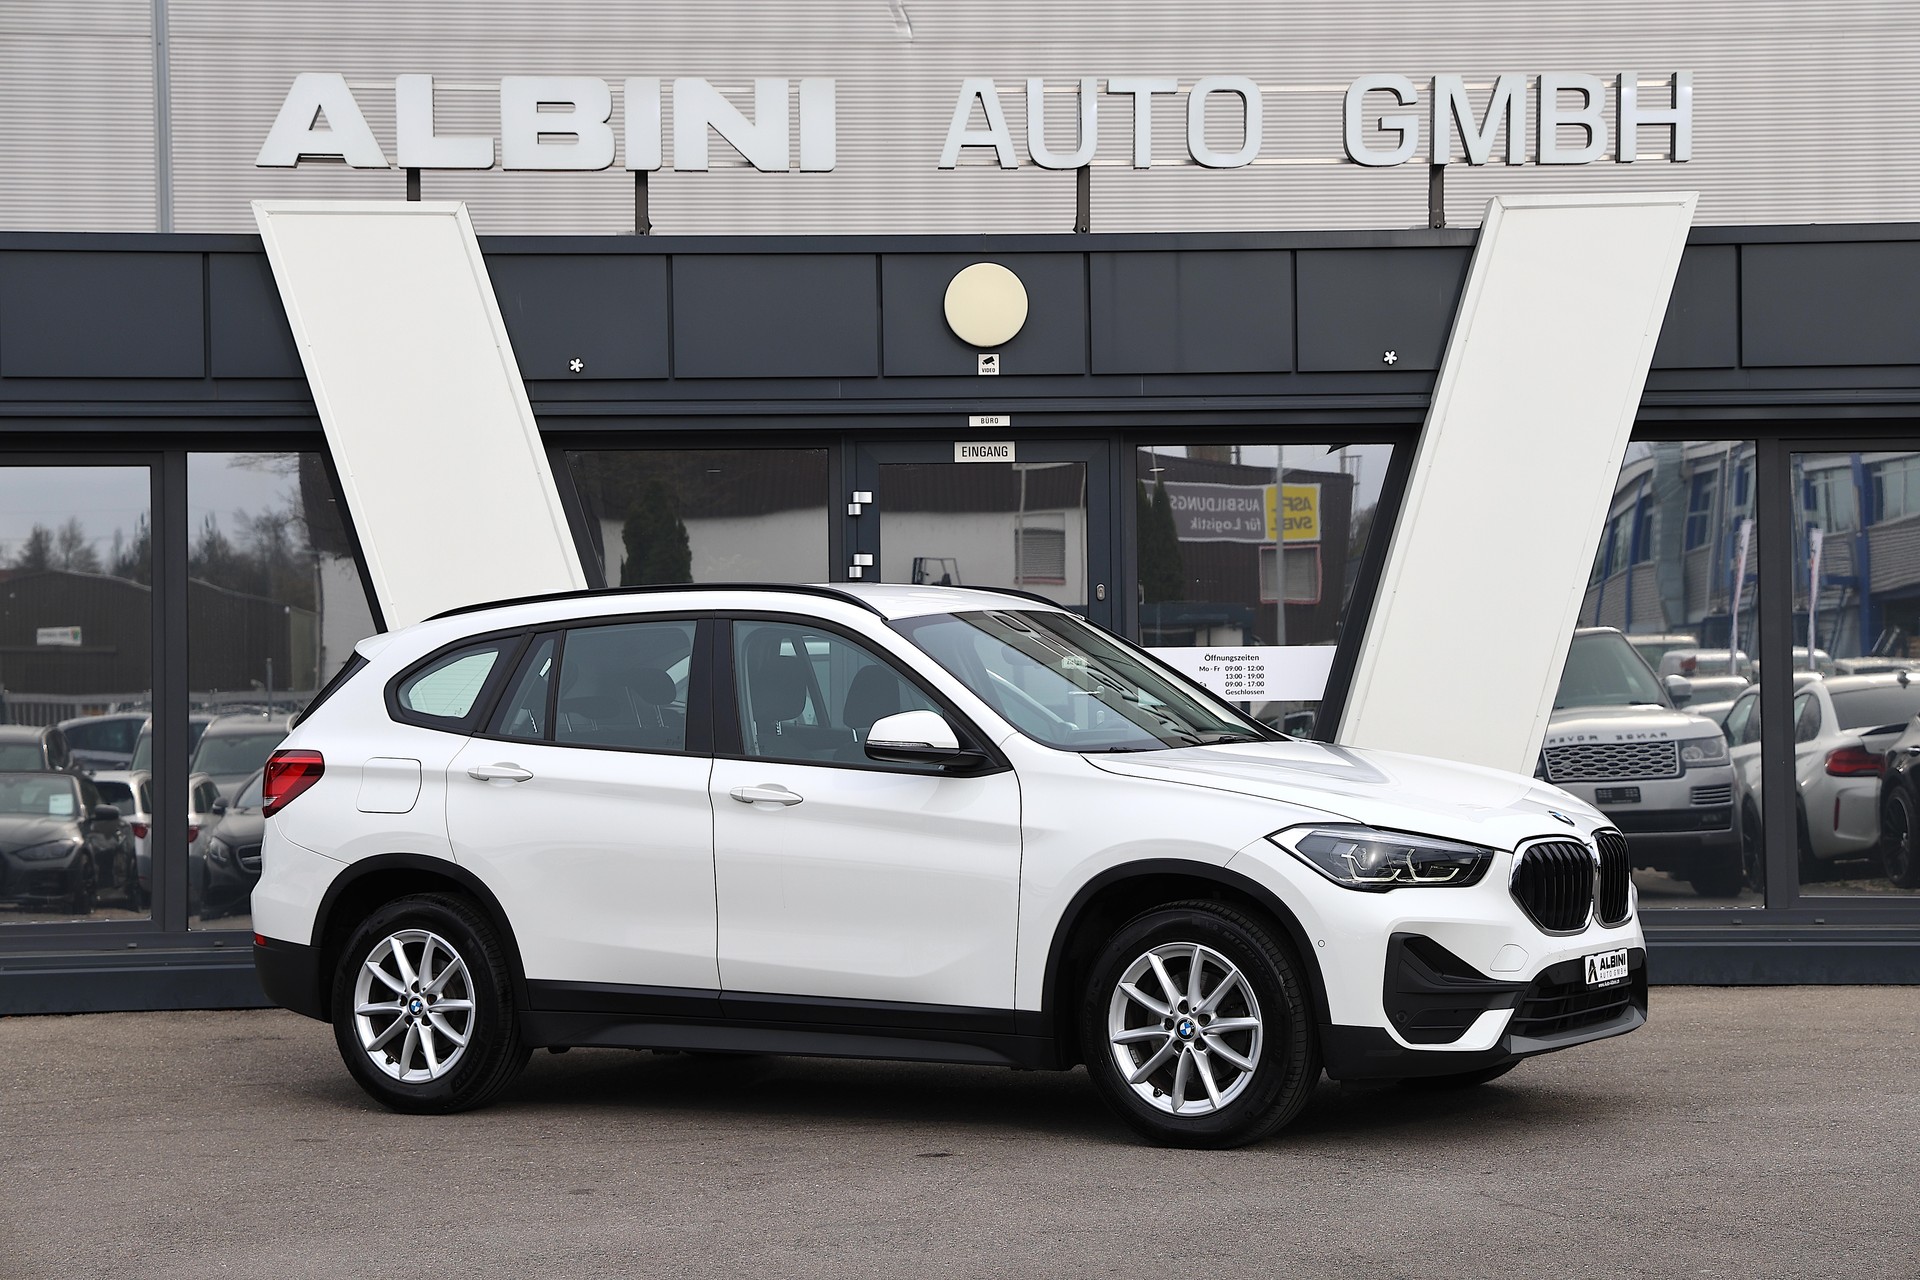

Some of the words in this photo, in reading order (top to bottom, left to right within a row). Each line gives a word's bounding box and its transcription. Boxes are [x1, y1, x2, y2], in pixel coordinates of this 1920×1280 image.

[256, 72, 836, 172] ALBINI
[938, 75, 1263, 170] AUTO
[1342, 71, 1693, 165] GMBH
[962, 446, 1008, 457] EINGANG
[1204, 653, 1260, 662] Öffnungszeiten
[1600, 953, 1626, 970] ALBINI
